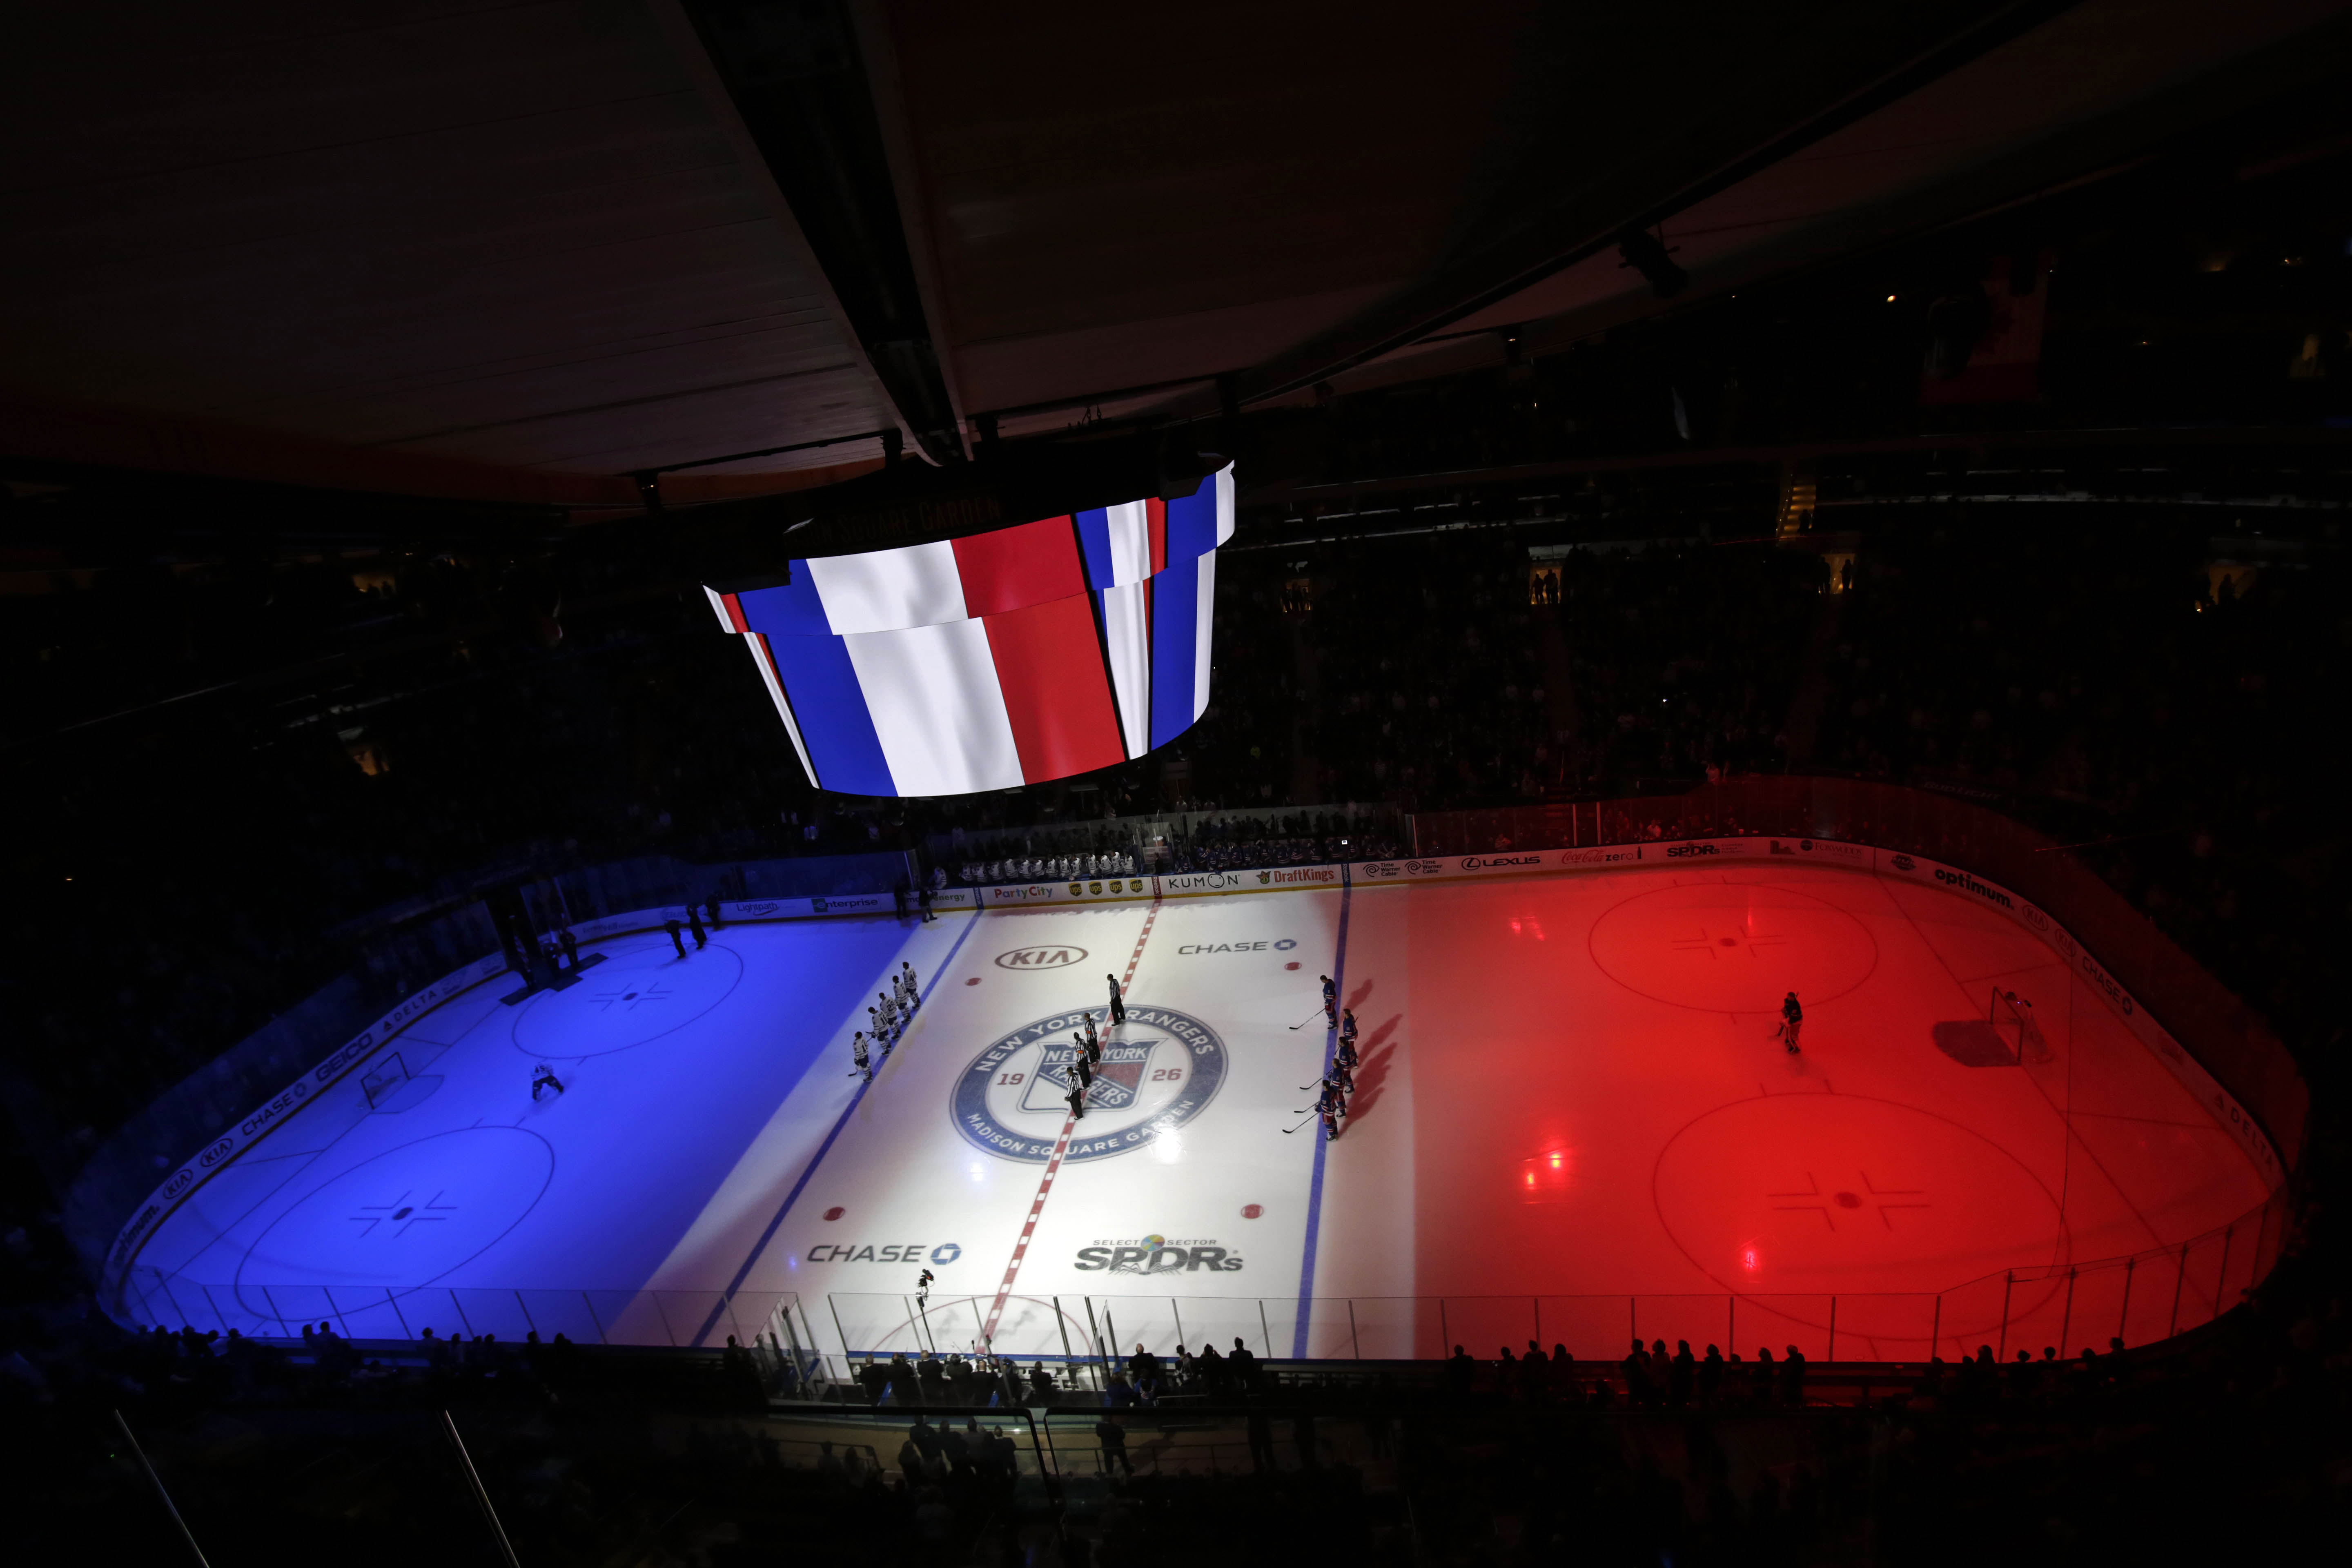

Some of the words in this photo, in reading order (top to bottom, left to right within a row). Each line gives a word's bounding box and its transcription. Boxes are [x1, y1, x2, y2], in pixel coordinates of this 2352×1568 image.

[1483, 856, 1540, 866] LEXUS
[1169, 873, 1239, 889] KUMON
[1274, 869, 1334, 883] DraftKings
[1070, 887, 1082, 897] ups
[1090, 885, 1102, 895] ups
[1110, 884, 1122, 894] ups
[1130, 883, 1142, 892] ups
[736, 902, 777, 912] Lightpath
[2027, 908, 2044, 928] KIA
[1178, 941, 1269, 955] CHASE
[1009, 950, 1069, 965] KIA
[2084, 956, 2120, 1004] CHASE
[394, 990, 437, 1021] DELTA
[976, 1036, 1022, 1071] NEW
[1125, 1009, 1214, 1054] RANGERS
[316, 1033, 372, 1081] GEICO
[1103, 1048, 1146, 1059] YORK
[996, 1074, 1025, 1085] 19
[1152, 1069, 1182, 1081] 26
[242, 1093, 293, 1136] CHASE
[967, 1114, 1025, 1152] MADISON
[1028, 1138, 1120, 1155] SQUARE
[2231, 1107, 2272, 1173] DELTA
[206, 1143, 228, 1164] KIA
[168, 1174, 188, 1194] KIA
[807, 1245, 927, 1262] CHASE
[1074, 1247, 1243, 1272] SPDRs
